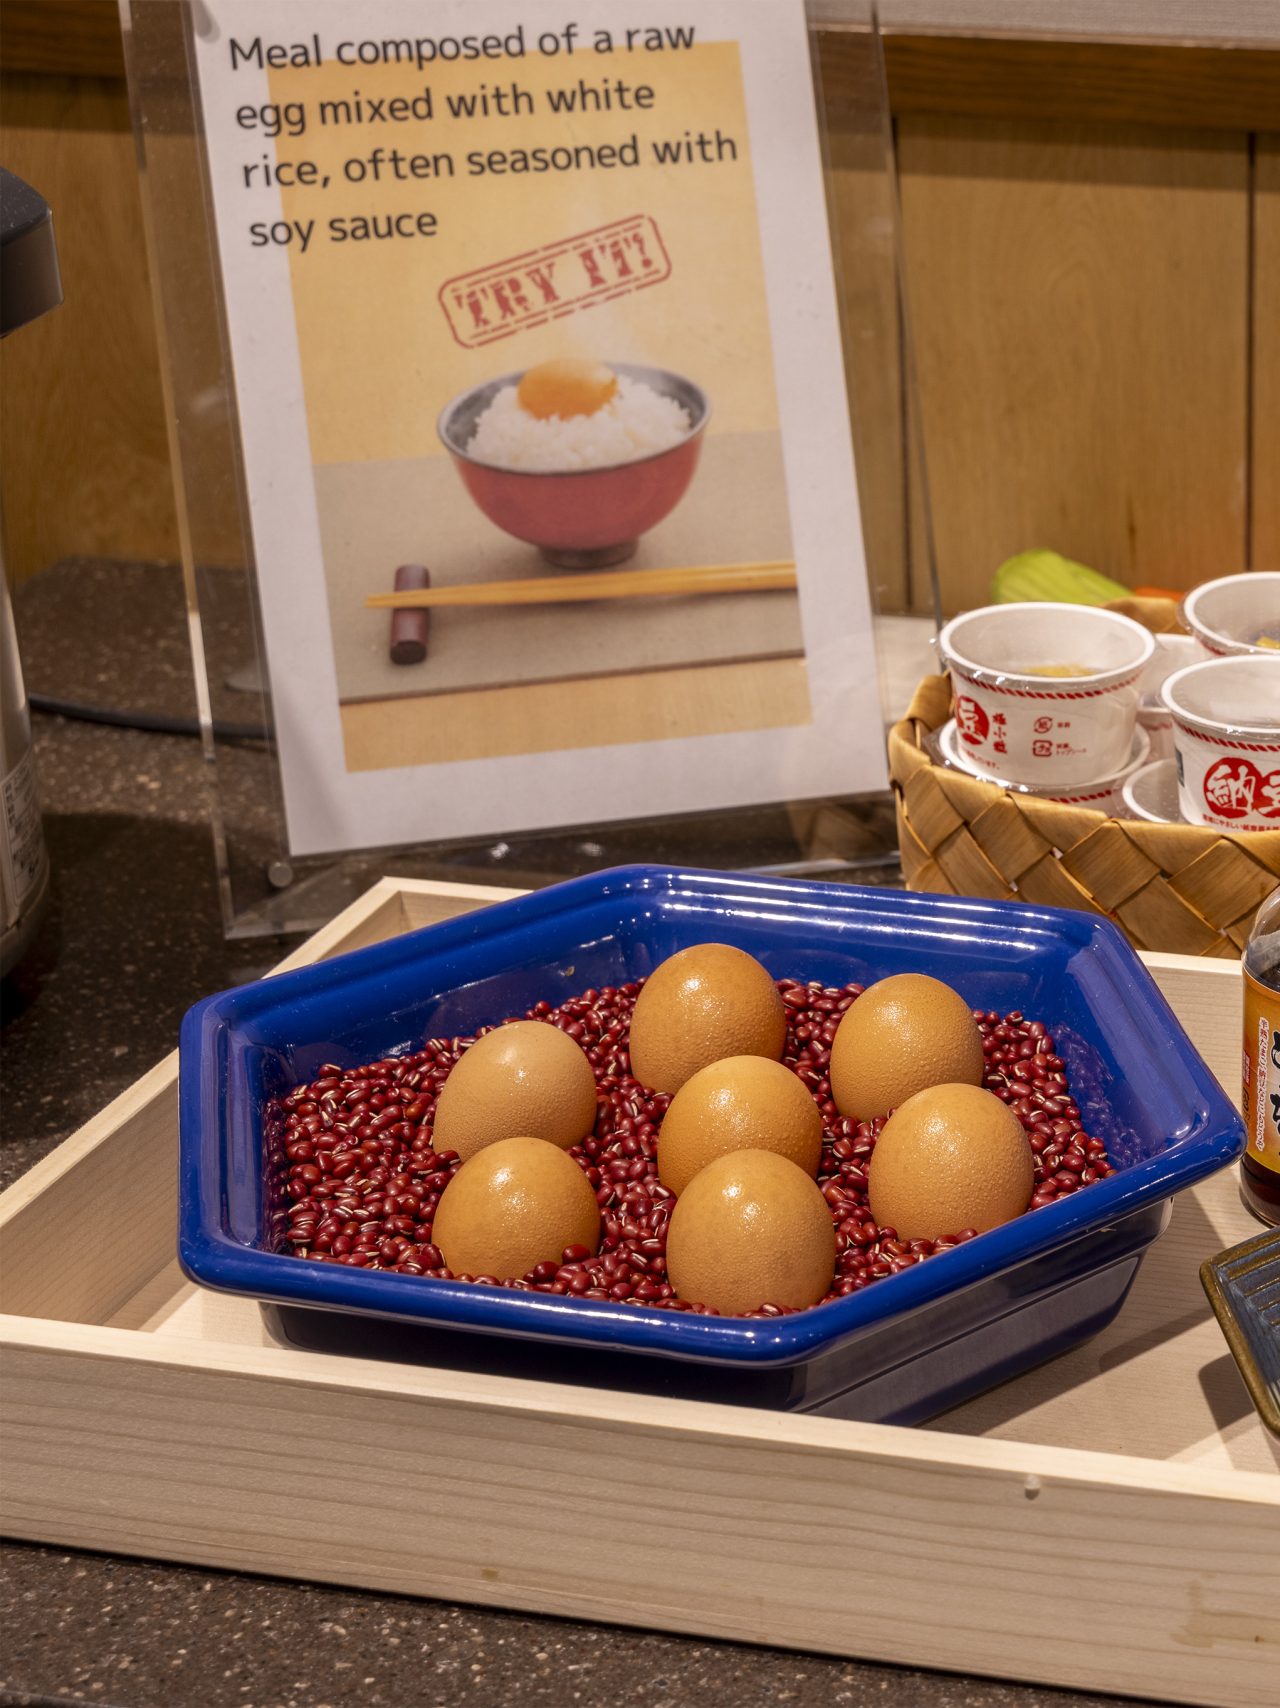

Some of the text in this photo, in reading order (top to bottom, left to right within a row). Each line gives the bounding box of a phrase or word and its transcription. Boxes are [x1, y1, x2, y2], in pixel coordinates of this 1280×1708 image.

[229, 23, 696, 70] Meal composed of a raw
[236, 79, 656, 137] egg mixed with white
[243, 130, 738, 189] rice, often seasoned with
[249, 212, 438, 253] soy sauce
[454, 233, 654, 329] TRY IT!
